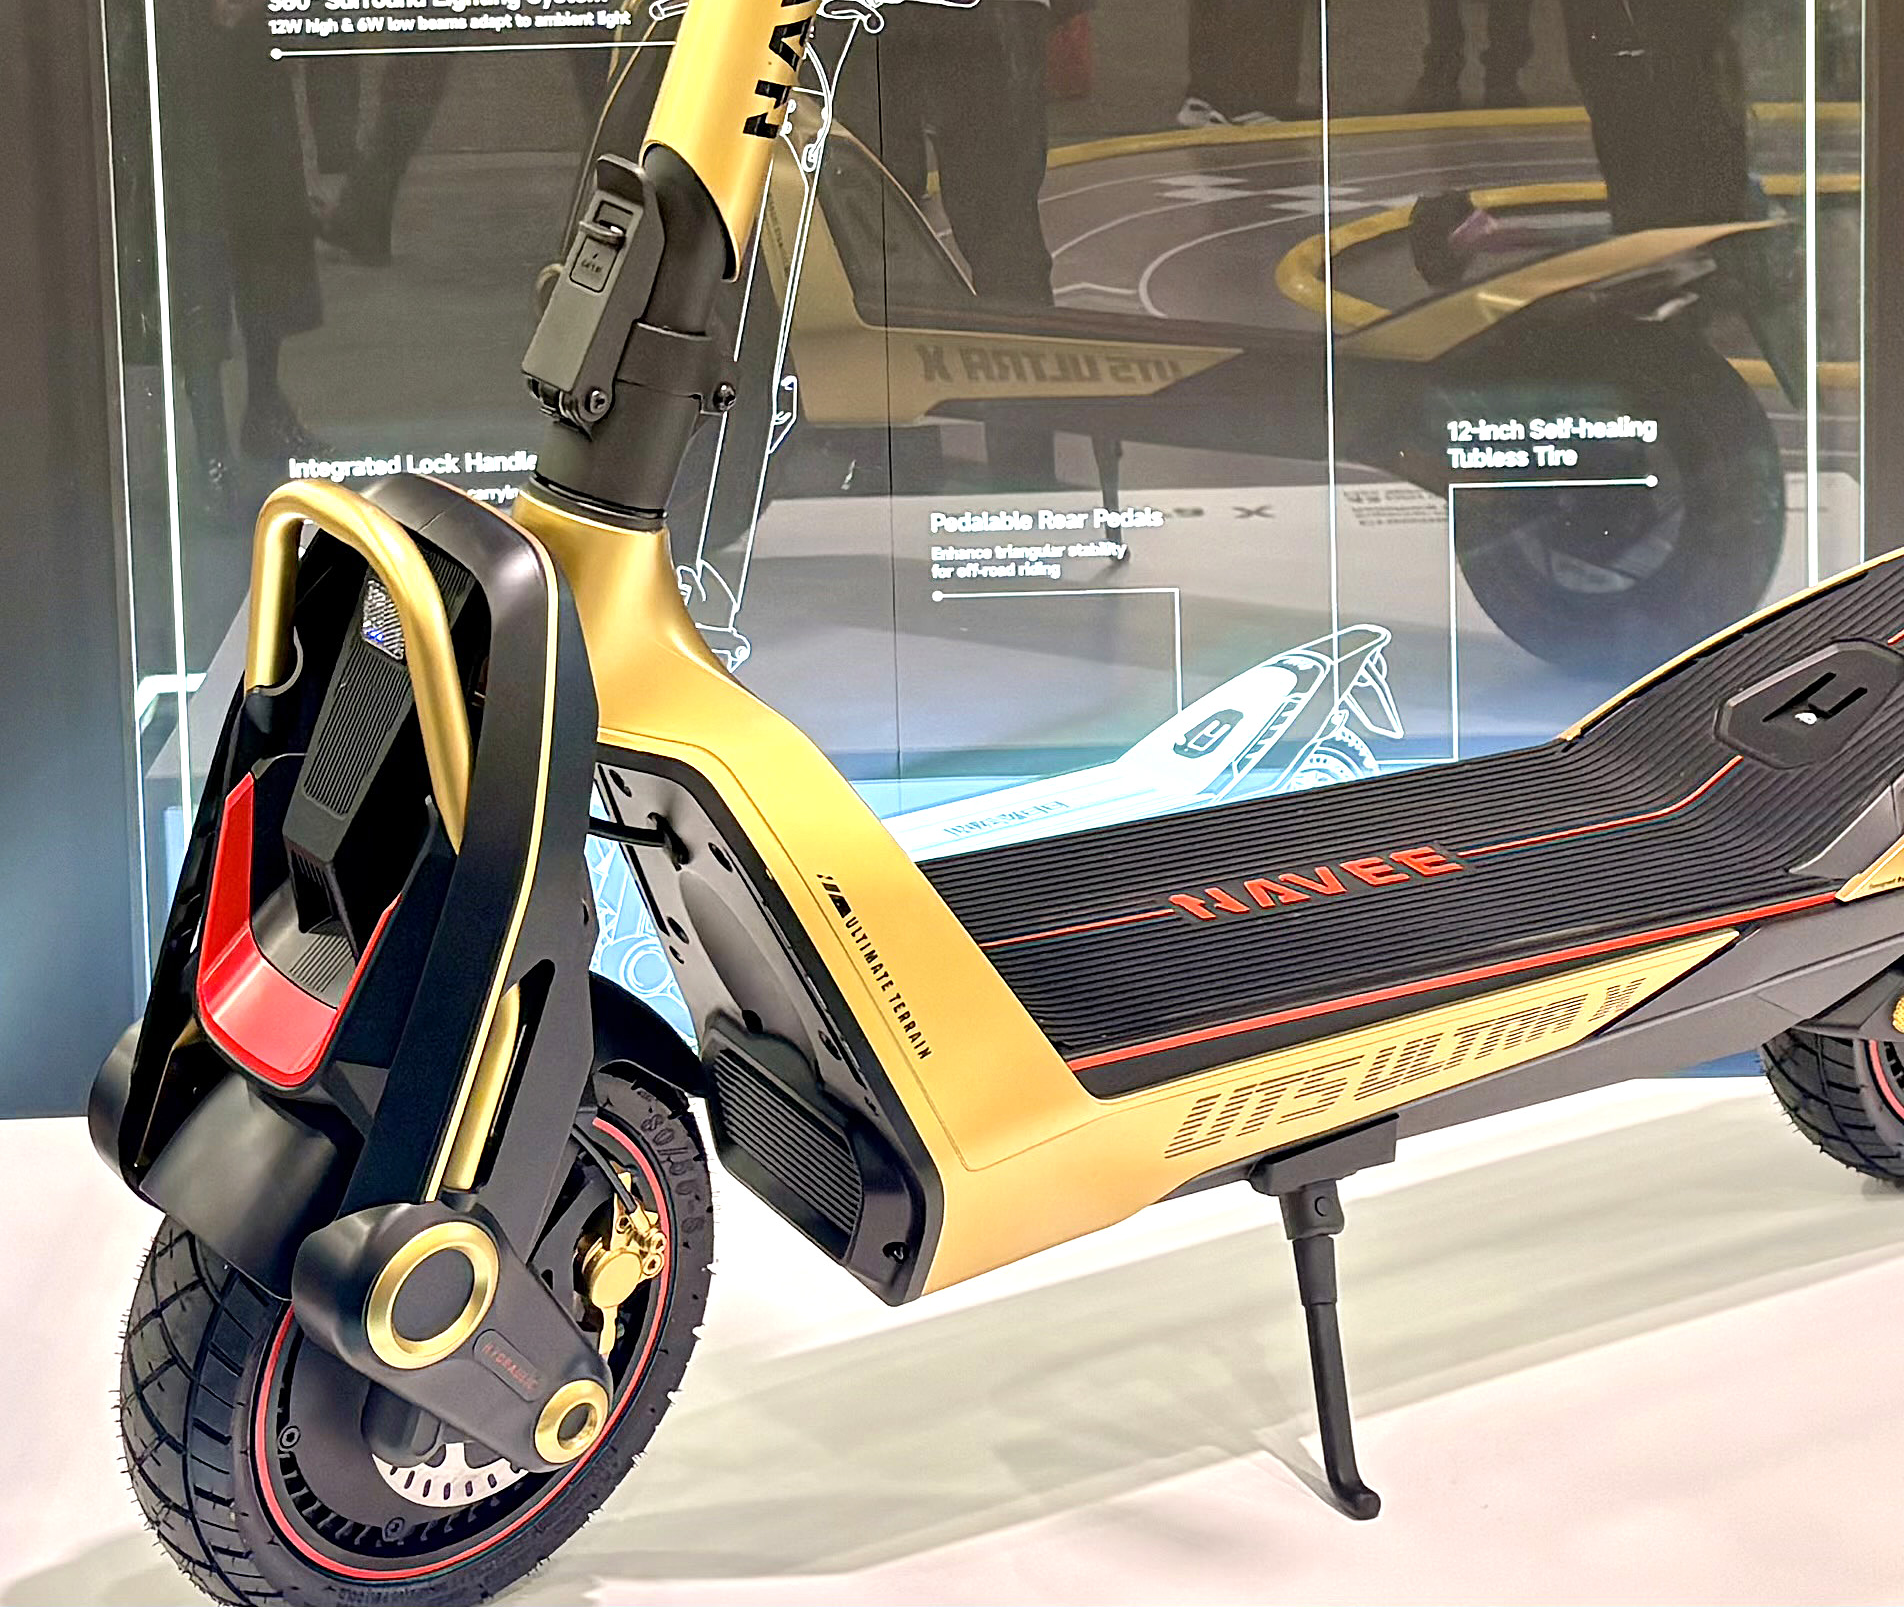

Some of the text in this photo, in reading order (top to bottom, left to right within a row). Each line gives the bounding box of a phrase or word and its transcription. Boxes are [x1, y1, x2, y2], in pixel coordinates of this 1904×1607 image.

[268, 19, 303, 35] 12W
[306, 17, 339, 38] high
[418, 14, 468, 31] beams
[470, 13, 512, 33] adapt
[515, 13, 531, 29] to
[534, 11, 595, 29] ambient
[597, 10, 632, 30] light
[1446, 415, 1658, 443] 12-inch Self-healing
[288, 450, 538, 483] Integrated Lock Handle
[1532, 444, 1578, 467] Tire
[930, 510, 1034, 534] Pedalable
[1038, 509, 1089, 531] Rear
[1092, 506, 1165, 529] Pedals
[930, 540, 1128, 563] Enhance triangular stability
[931, 560, 1062, 582] for off-road riding
[1167, 844, 1464, 920] NAVEE
[845, 916, 933, 1060] ULTIMATE TERRAIN
[1165, 1053, 1365, 1155] UT5
[1353, 992, 1590, 1101] ULTRA
